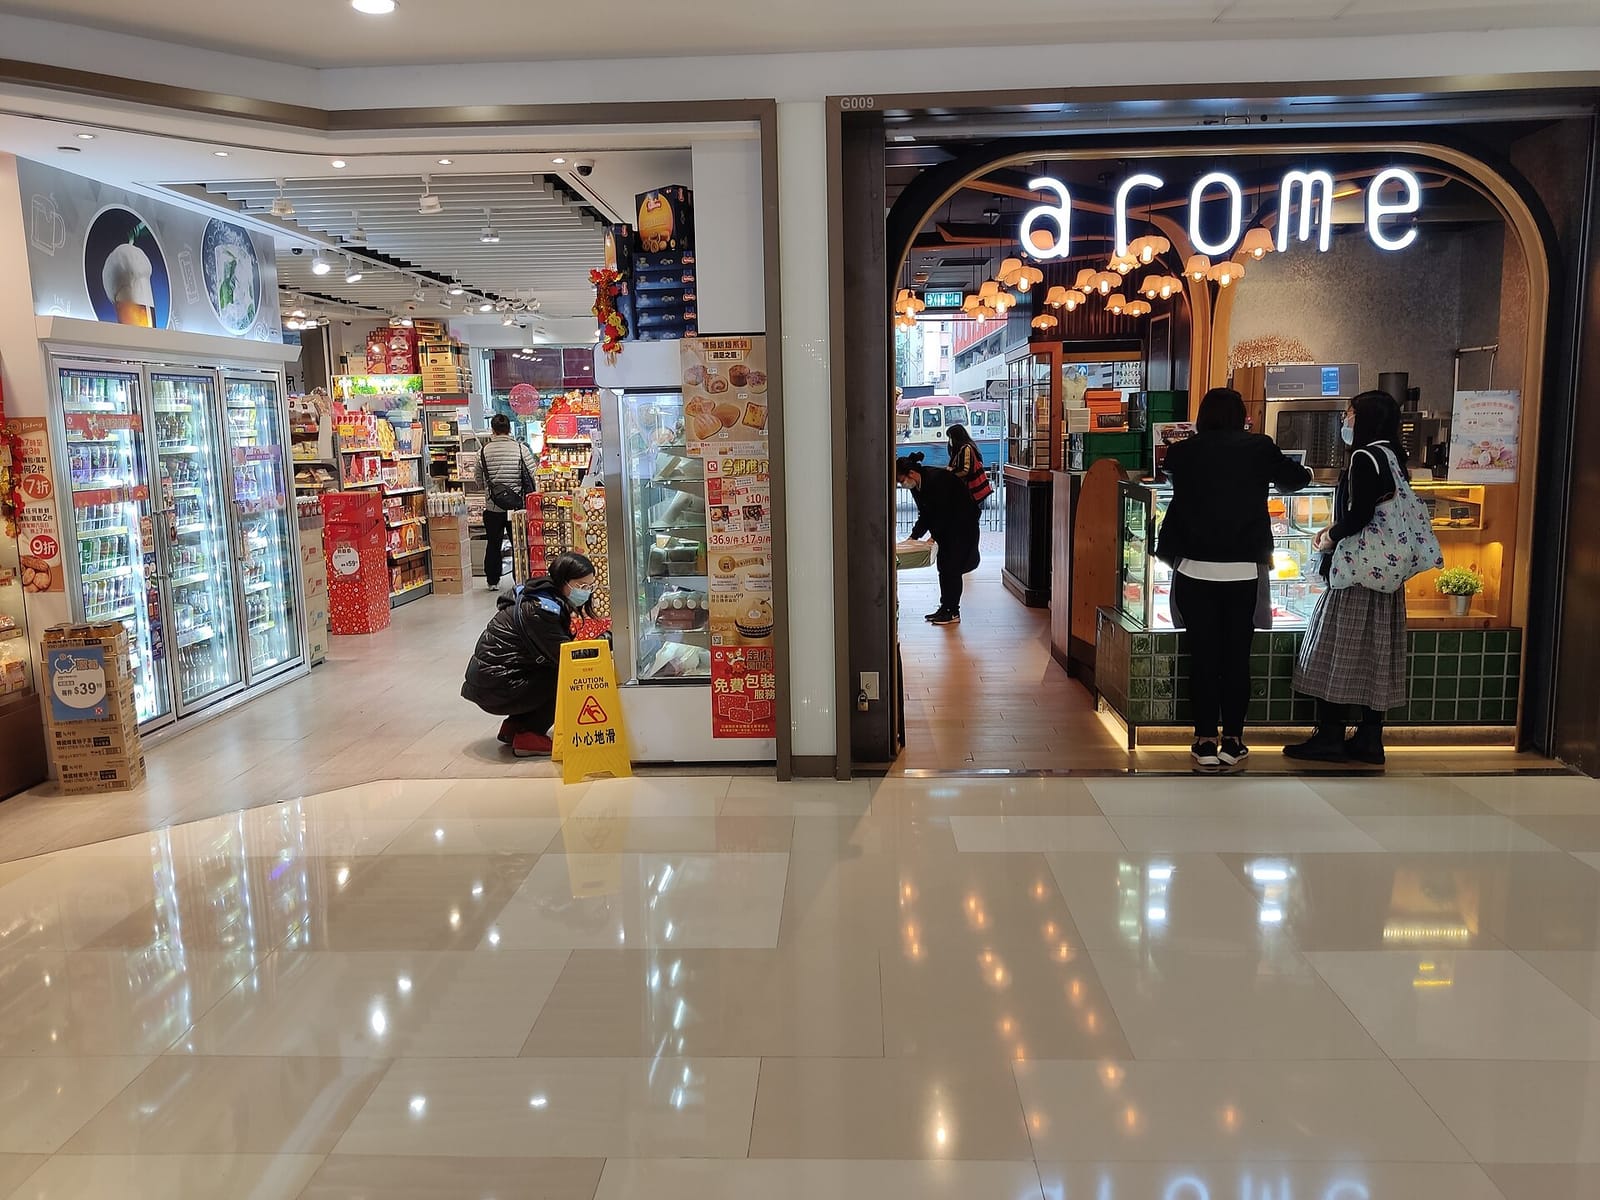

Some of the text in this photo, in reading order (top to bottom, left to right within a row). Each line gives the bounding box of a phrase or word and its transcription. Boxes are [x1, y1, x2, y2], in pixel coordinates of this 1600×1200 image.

[840, 97, 874, 109] G009
[1018, 167, 1421, 259] arome
[926, 294, 942, 306] EXIT
[945, 293, 961, 305] 出口
[721, 458, 769, 476] 今期推介
[25, 478, 49, 495] 7折
[32, 539, 56, 556] 9折
[573, 676, 604, 685] CAUTION
[74, 682, 96, 695] $39
[570, 682, 609, 692] WET FLOOR
[754, 689, 775, 700] 服務
[572, 728, 616, 748] 小心地滑
